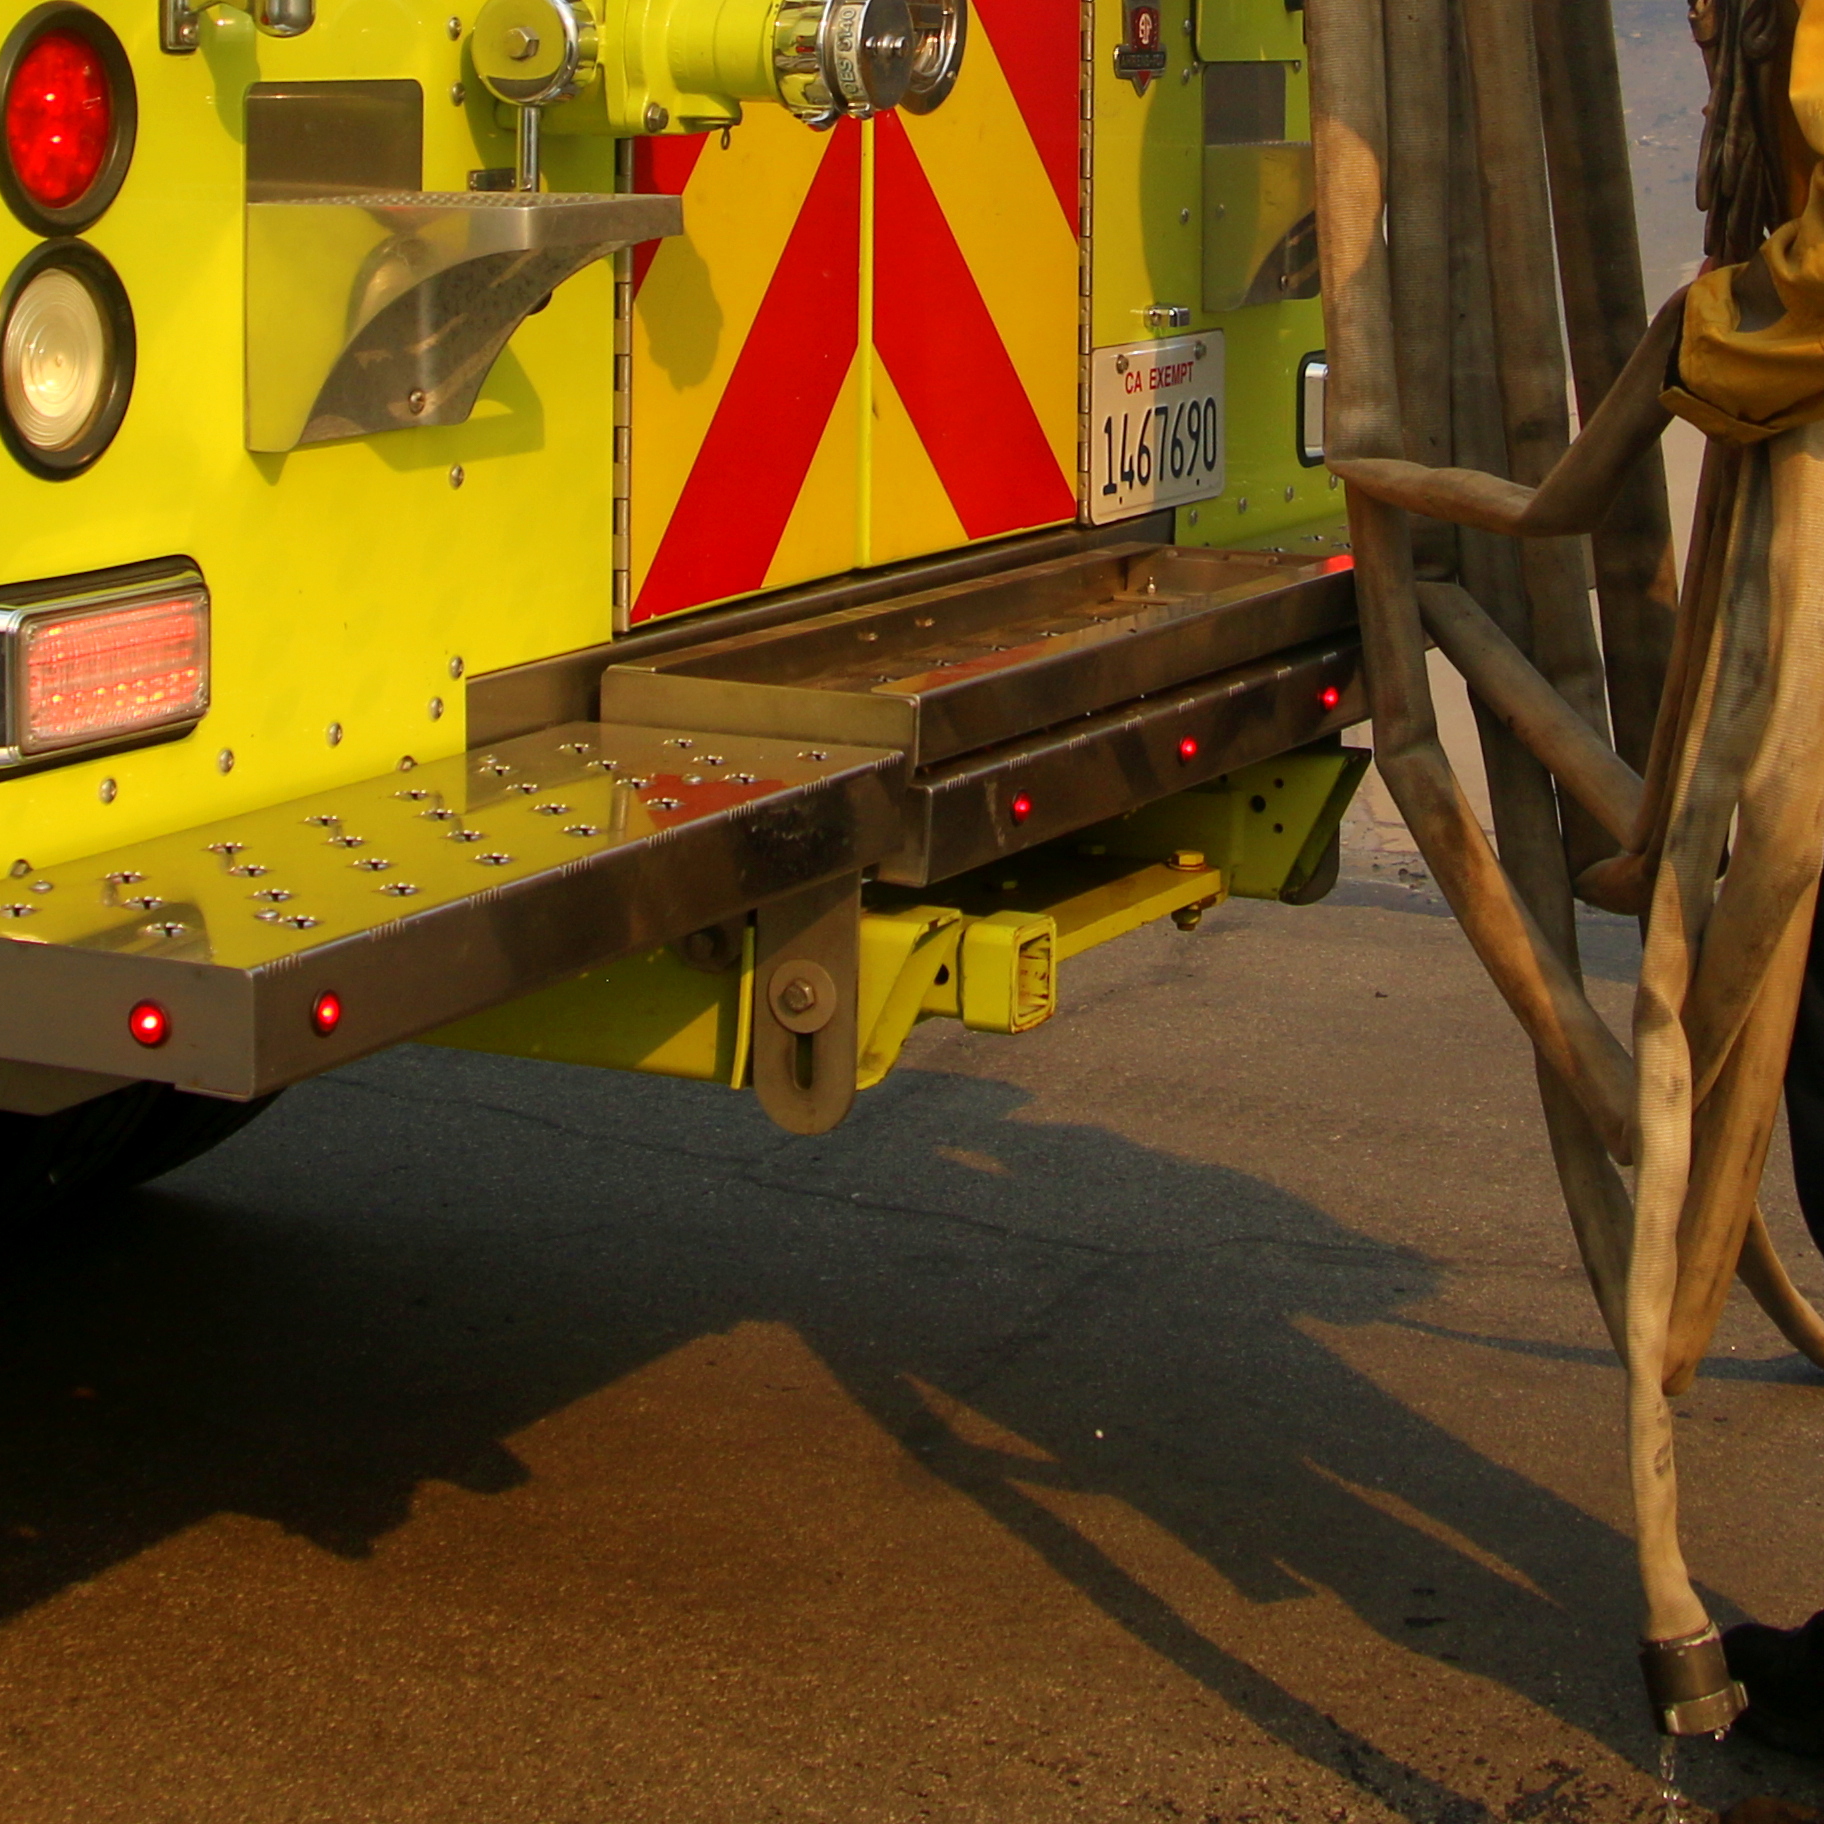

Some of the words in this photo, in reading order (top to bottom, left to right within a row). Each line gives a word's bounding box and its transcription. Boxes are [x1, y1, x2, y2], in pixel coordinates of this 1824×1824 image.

[837, 58, 859, 95] OES
[1125, 369, 1143, 395] CA
[1149, 361, 1195, 391] EXEMPT
[1103, 396, 1217, 497] 1467690
